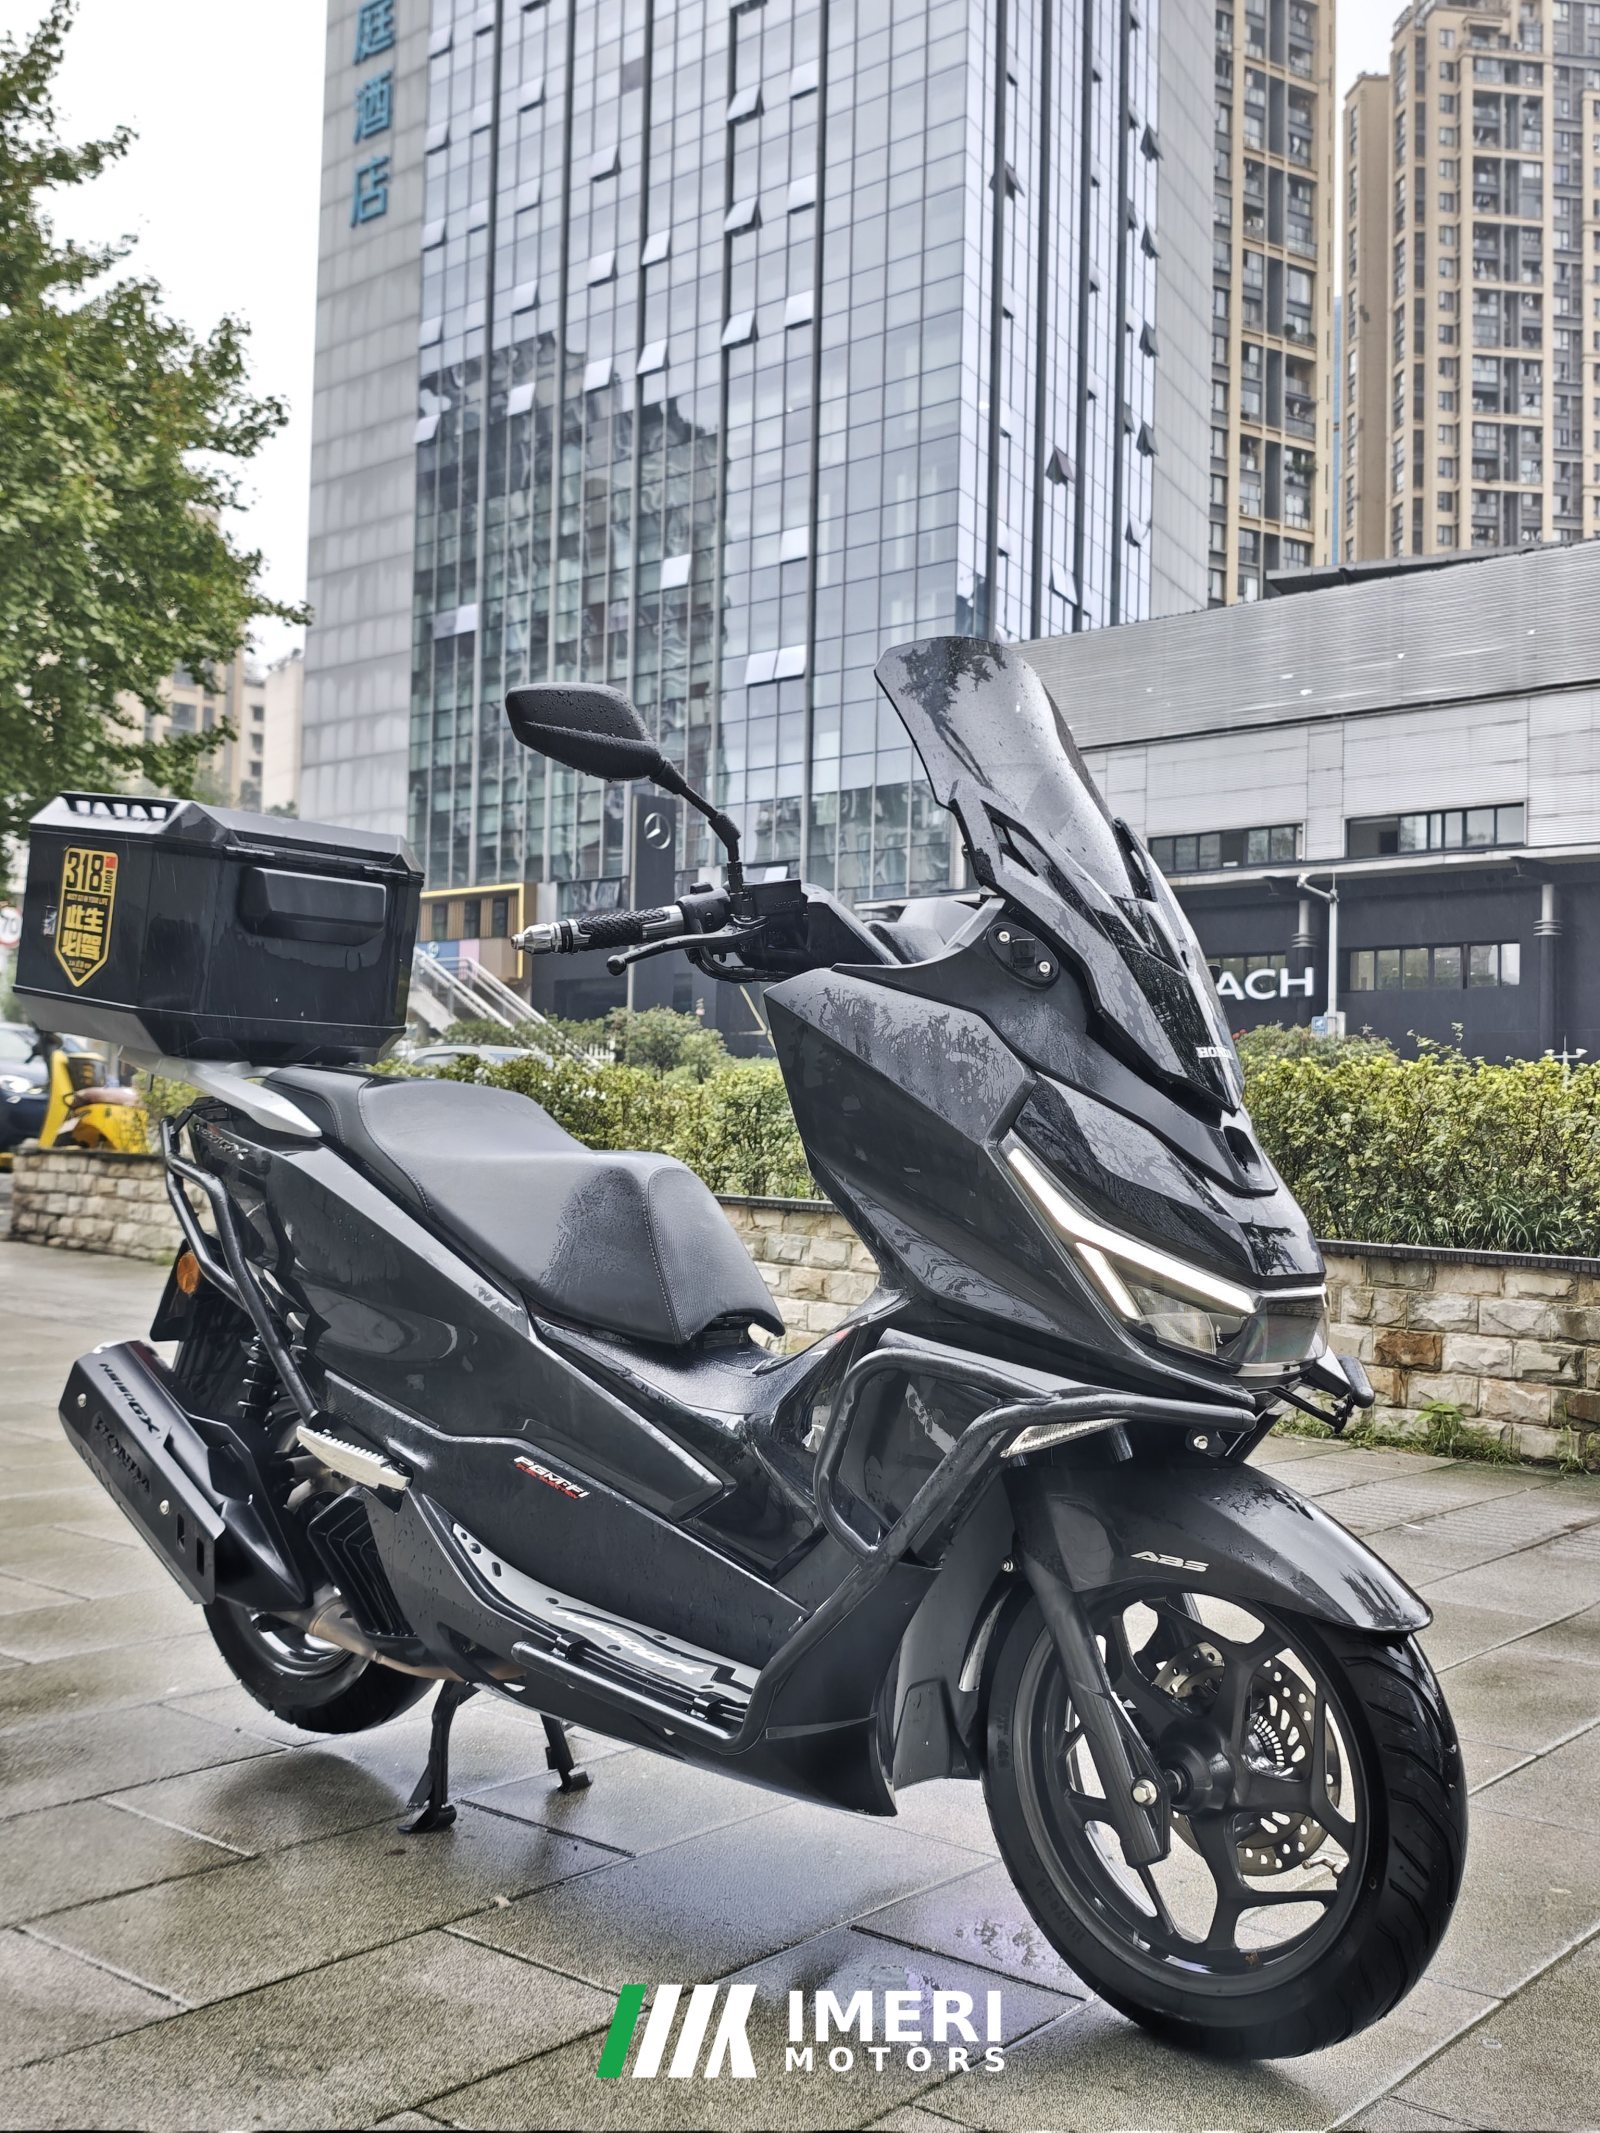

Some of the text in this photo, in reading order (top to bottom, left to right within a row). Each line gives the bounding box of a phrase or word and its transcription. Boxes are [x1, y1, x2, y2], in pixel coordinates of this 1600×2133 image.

[66, 852, 104, 891] 318
[104, 870, 114, 893] ROUTE
[1130, 1550, 1210, 1573] ABS
